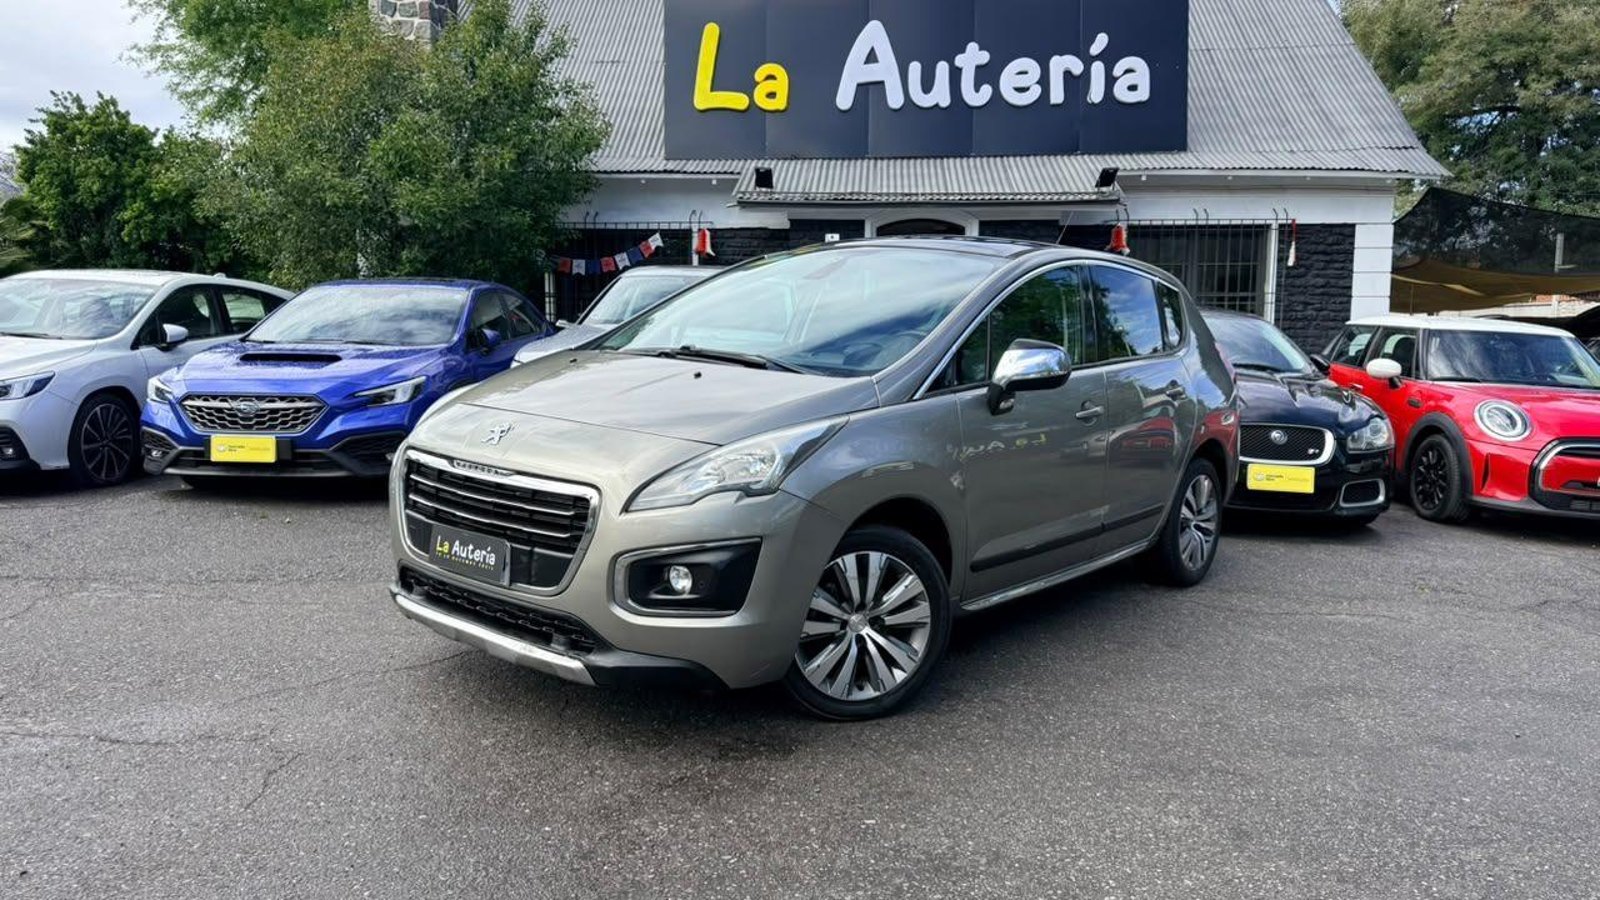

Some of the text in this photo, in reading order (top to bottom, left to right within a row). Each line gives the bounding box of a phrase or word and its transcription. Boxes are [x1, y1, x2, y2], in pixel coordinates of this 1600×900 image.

[693, 19, 1151, 111] La Autería
[436, 535, 450, 553] La
[451, 540, 496, 565] Autería
